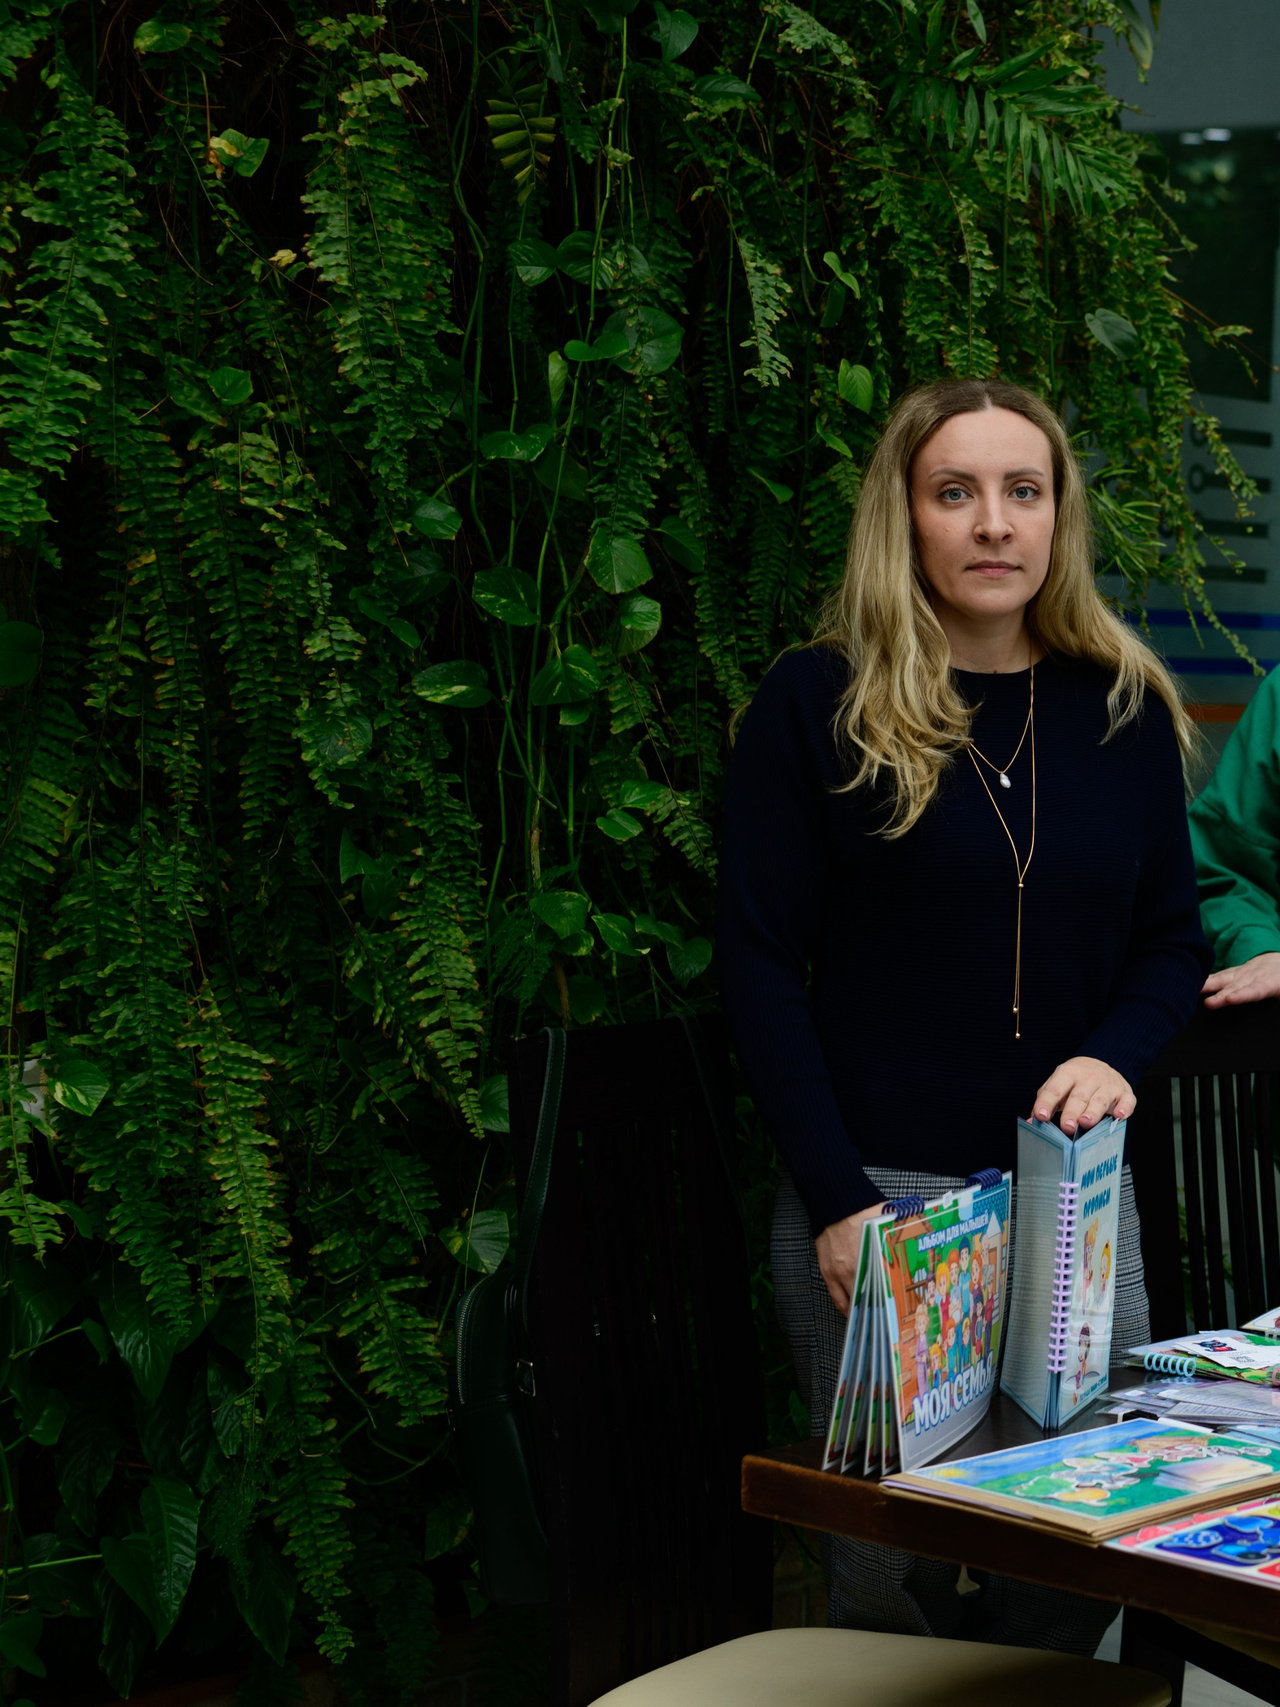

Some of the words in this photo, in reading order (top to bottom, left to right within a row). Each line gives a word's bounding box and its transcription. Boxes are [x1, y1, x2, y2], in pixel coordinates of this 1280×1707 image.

[918, 1230, 945, 1252] АЛЬБОМ
[946, 1226, 959, 1244] ДЛЯ
[959, 1210, 989, 1238] МАЛЫШЕЙ
[913, 1380, 952, 1435] МОЯ
[953, 1351, 994, 1412] СЕМЬЯ
